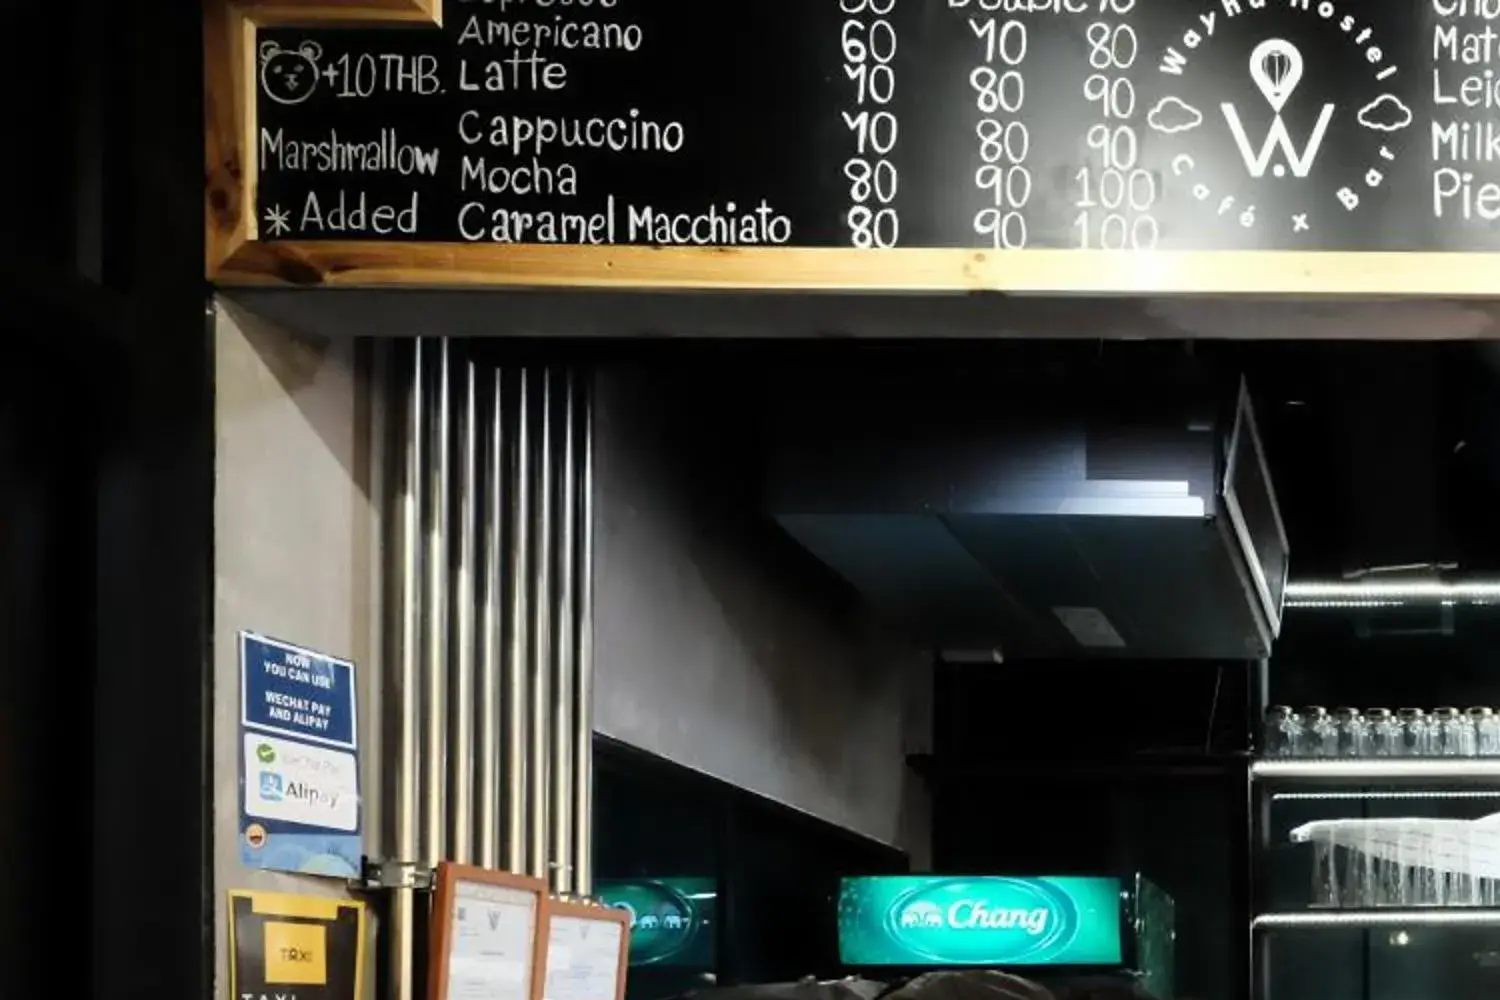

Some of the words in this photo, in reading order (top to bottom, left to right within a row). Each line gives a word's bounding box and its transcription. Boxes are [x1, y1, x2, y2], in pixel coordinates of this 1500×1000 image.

[457, 15, 642, 51] Americano
[840, 19, 897, 63] 60
[1086, 22, 1137, 69] 80
[459, 48, 567, 91] Latte
[969, 66, 1024, 113] 80
[1084, 74, 1135, 119] 90
[262, 127, 440, 176] Marshmallow
[459, 108, 684, 155] Cappuccino
[976, 119, 1029, 163] 80
[1086, 124, 1137, 170] 90
[461, 155, 577, 195] Mocha
[844, 158, 897, 203] 80
[975, 164, 1031, 208] 90
[1075, 166, 1155, 211] 100
[1336, 146, 1395, 211] Bar
[300, 189, 418, 234] Added
[458, 194, 615, 244] Caramel
[628, 199, 792, 244] Macchiato
[847, 205, 898, 249] 80
[973, 208, 1026, 249] 90
[1073, 210, 1159, 249] 100
[263, 660, 286, 677] YOU
[288, 667, 310, 683] CAN
[311, 674, 331, 689] USE
[285, 653, 311, 669] NOW
[265, 691, 309, 711] WECHAT
[311, 701, 332, 717] PAY
[269, 706, 291, 721] AND
[293, 712, 329, 731] ALIPAY
[948, 896, 1049, 935] Chang
